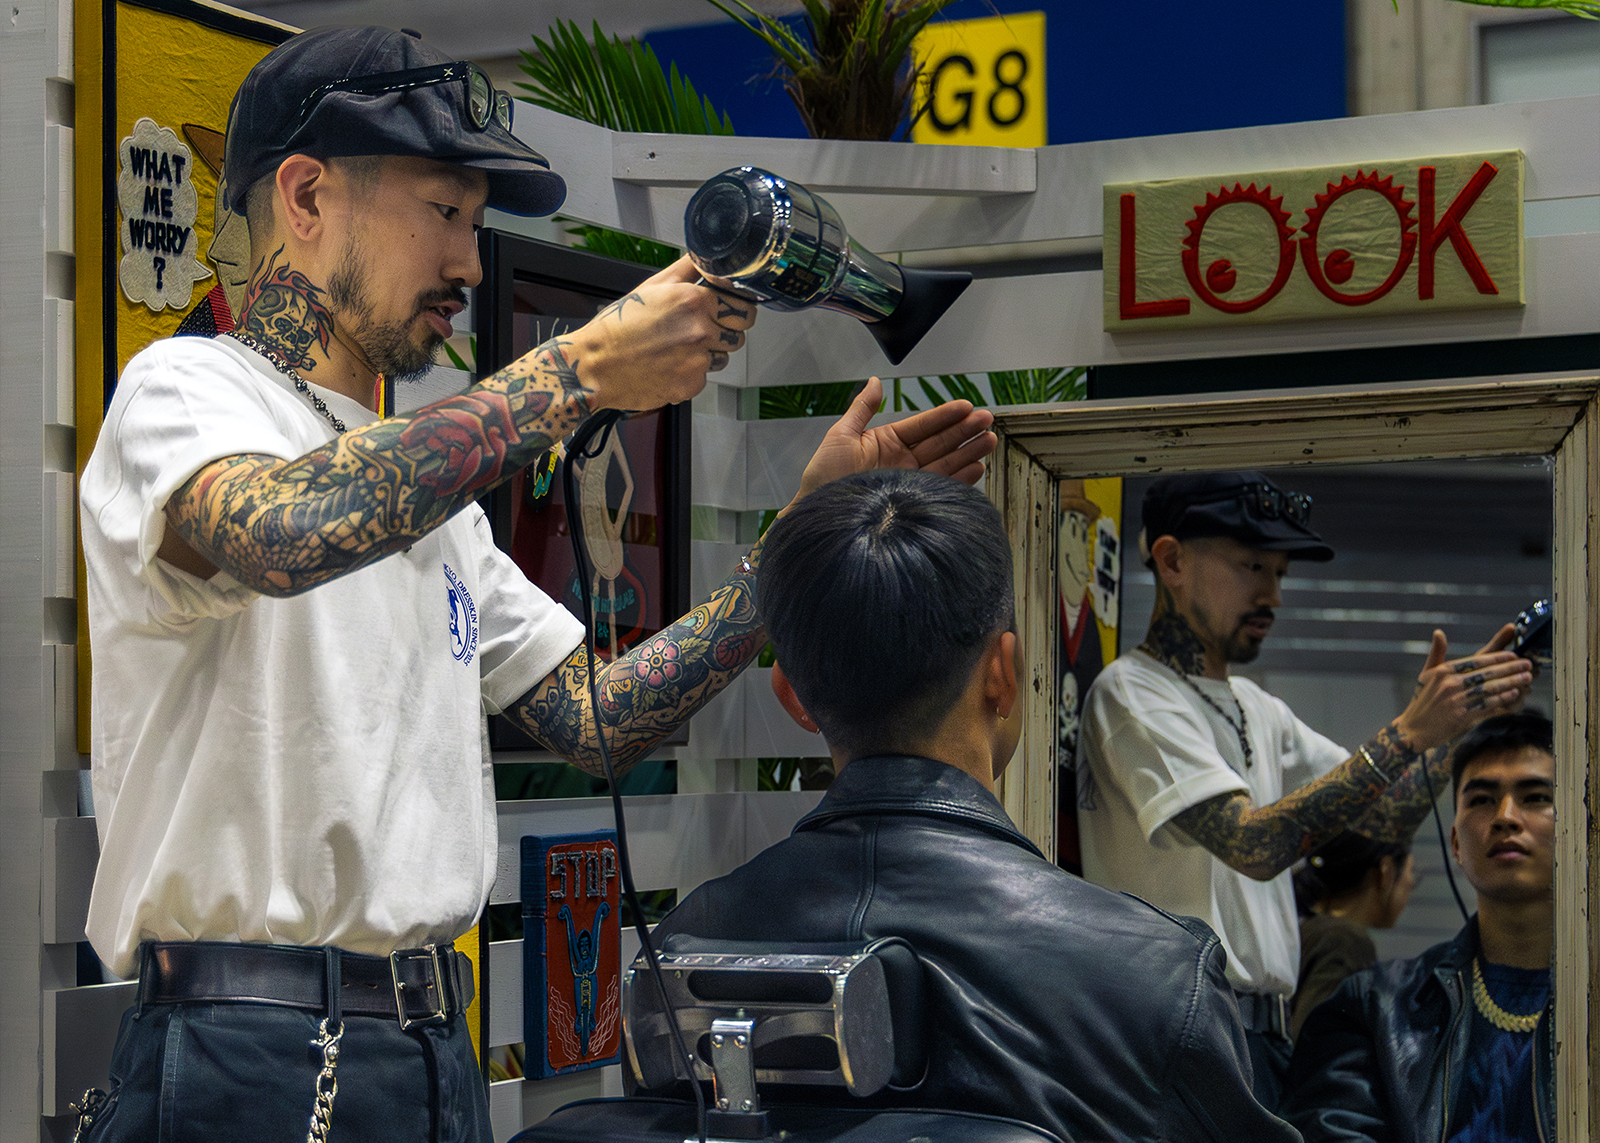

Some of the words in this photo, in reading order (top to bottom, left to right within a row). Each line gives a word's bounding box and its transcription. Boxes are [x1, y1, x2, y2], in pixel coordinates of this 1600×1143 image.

[929, 50, 1028, 133] G8
[129, 146, 186, 184] WHAT
[143, 185, 173, 218] ME
[129, 218, 191, 254] WORRY
[1119, 161, 1499, 320] LOOK
[153, 256, 166, 290] ?
[457, 581, 478, 624] DRESSKIN
[470, 626, 478, 652] SINCE
[549, 847, 617, 900] STOP
